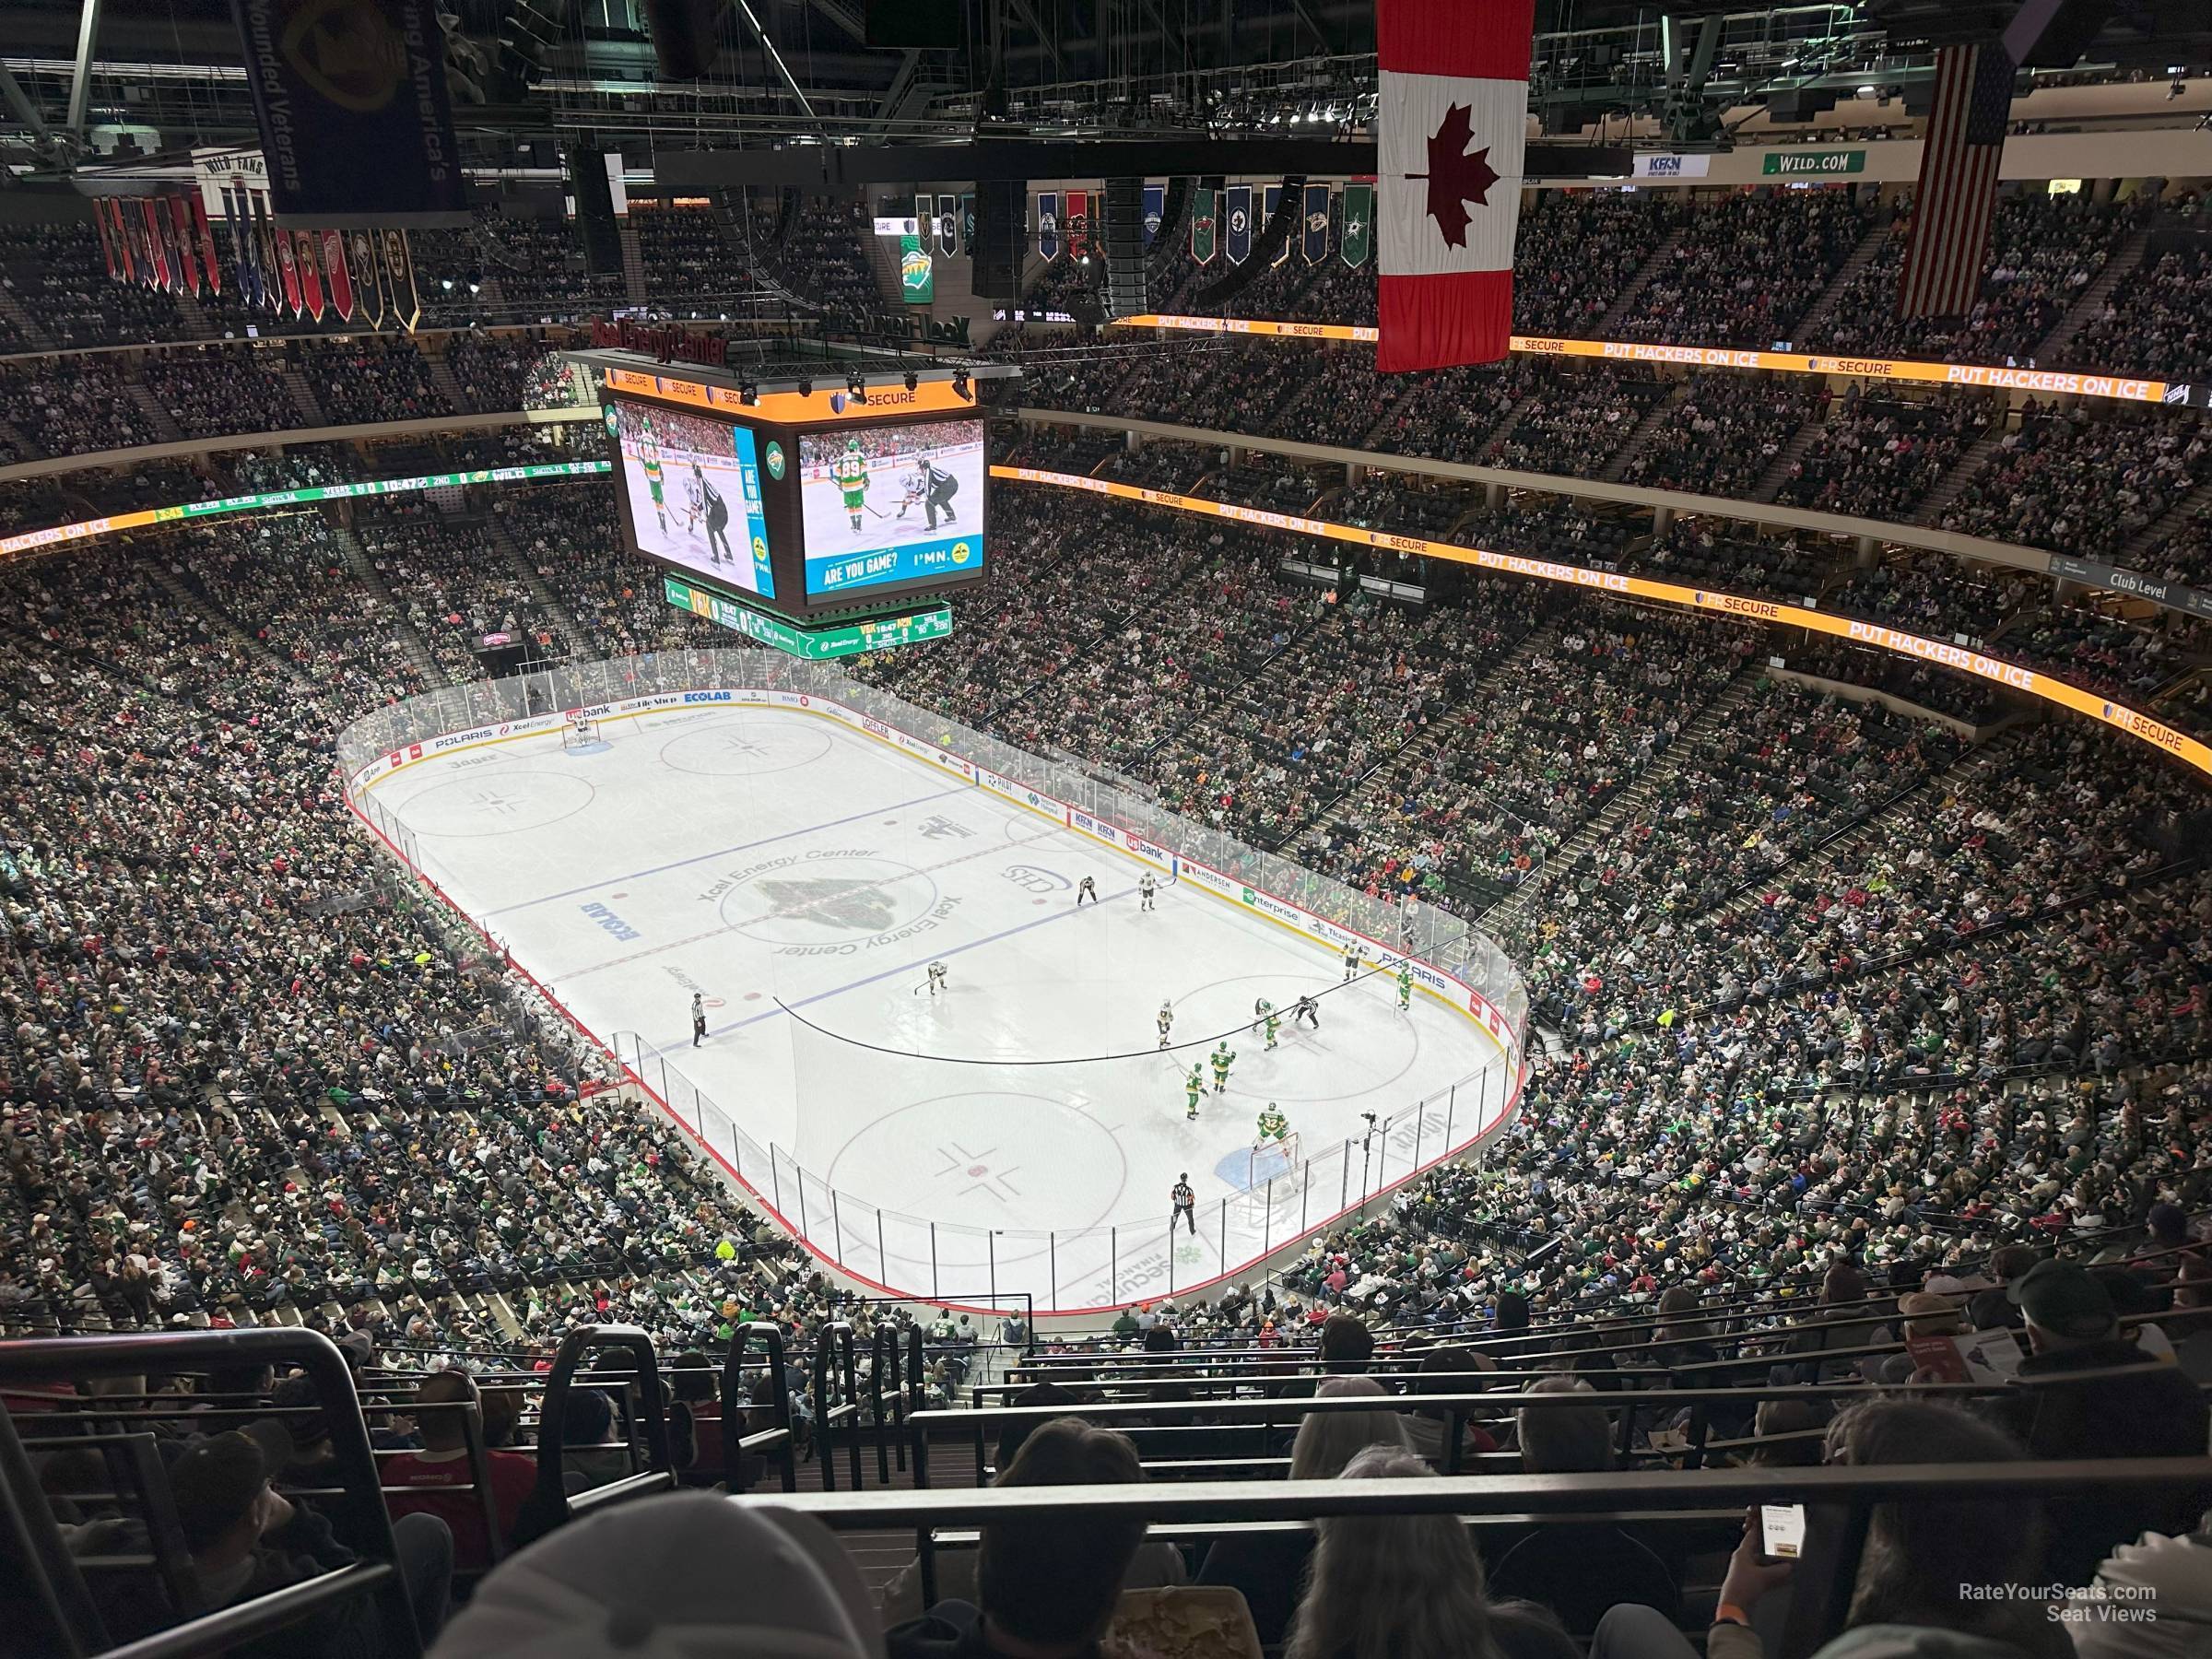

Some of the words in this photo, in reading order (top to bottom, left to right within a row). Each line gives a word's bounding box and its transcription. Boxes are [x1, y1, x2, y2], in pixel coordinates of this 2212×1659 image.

[412, 55, 450, 182] America's
[267, 99, 301, 192] Veterans
[204, 156, 231, 175] WILD
[237, 156, 264, 175] FANS
[1649, 157, 1682, 171] KFAN
[1159, 316, 1177, 327] PUT
[1180, 318, 1218, 329] HACKERS
[1234, 321, 1250, 332] ICE
[1353, 328, 1371, 340] PUT
[1605, 344, 1630, 357] PUT
[1635, 346, 1702, 363] HACKERS
[1707, 350, 1730, 364] ON
[1734, 352, 1759, 367] ICE
[1947, 367, 1984, 384] PUT
[1989, 370, 2079, 393] HACKERS
[2084, 377, 2112, 394] ON
[2117, 380, 2150, 399] ICE
[492, 470, 525, 481] WILD
[841, 459, 861, 479] 89
[1018, 468, 1038, 480] PUT
[1039, 471, 1080, 487] HACKERS
[1080, 477, 1094, 489] ON
[1094, 479, 1108, 492] ICE
[382, 478, 416, 492] 10:47
[433, 476, 450, 486] 2ND
[159, 507, 182, 521] 3:45
[1218, 504, 1238, 518] PUT
[1241, 508, 1287, 529] HACKERS
[1290, 519, 1304, 531] ON
[1308, 522, 1324, 535] ICE
[1, 529, 63, 552] HACKERS
[66, 524, 86, 537] ON
[89, 519, 110, 534] ICE
[824, 570, 843, 585] ARE
[845, 561, 865, 578] YOU
[866, 552, 899, 573] GAME?
[1478, 551, 1504, 568] PUT
[1508, 558, 1574, 582] HACKERS
[1577, 570, 1600, 586] ON
[1605, 575, 1629, 592] ICE
[2110, 573, 2136, 591] Club
[2138, 579, 2167, 599] Level
[1707, 593, 1779, 618] FRSECURE
[1849, 621, 1885, 643] PUT
[1889, 630, 1970, 669] HACKERS
[1974, 655, 2001, 679] ON
[2005, 665, 2034, 690] ICE
[654, 697, 677, 706] Shop
[684, 691, 731, 702] ECOLAB
[583, 704, 611, 719] bank
[862, 716, 889, 736] LOFFLER
[435, 729, 493, 749] POLARIS
[1140, 842, 1163, 861] bank
[697, 878, 733, 902] Xcel
[729, 855, 798, 880] Energy
[805, 848, 880, 860] Center
[1197, 868, 1230, 888] ANDERSEN
[933, 895, 962, 920] Xcel
[1246, 892, 1299, 922] enterprise
[580, 901, 641, 943] ECOLAB
[865, 920, 939, 949] Energy
[772, 944, 858, 957] Center
[1381, 952, 1446, 990] POARIS
[1265, 1118, 1277, 1128] 32
[1096, 1253, 1163, 1289] FINANCAL
